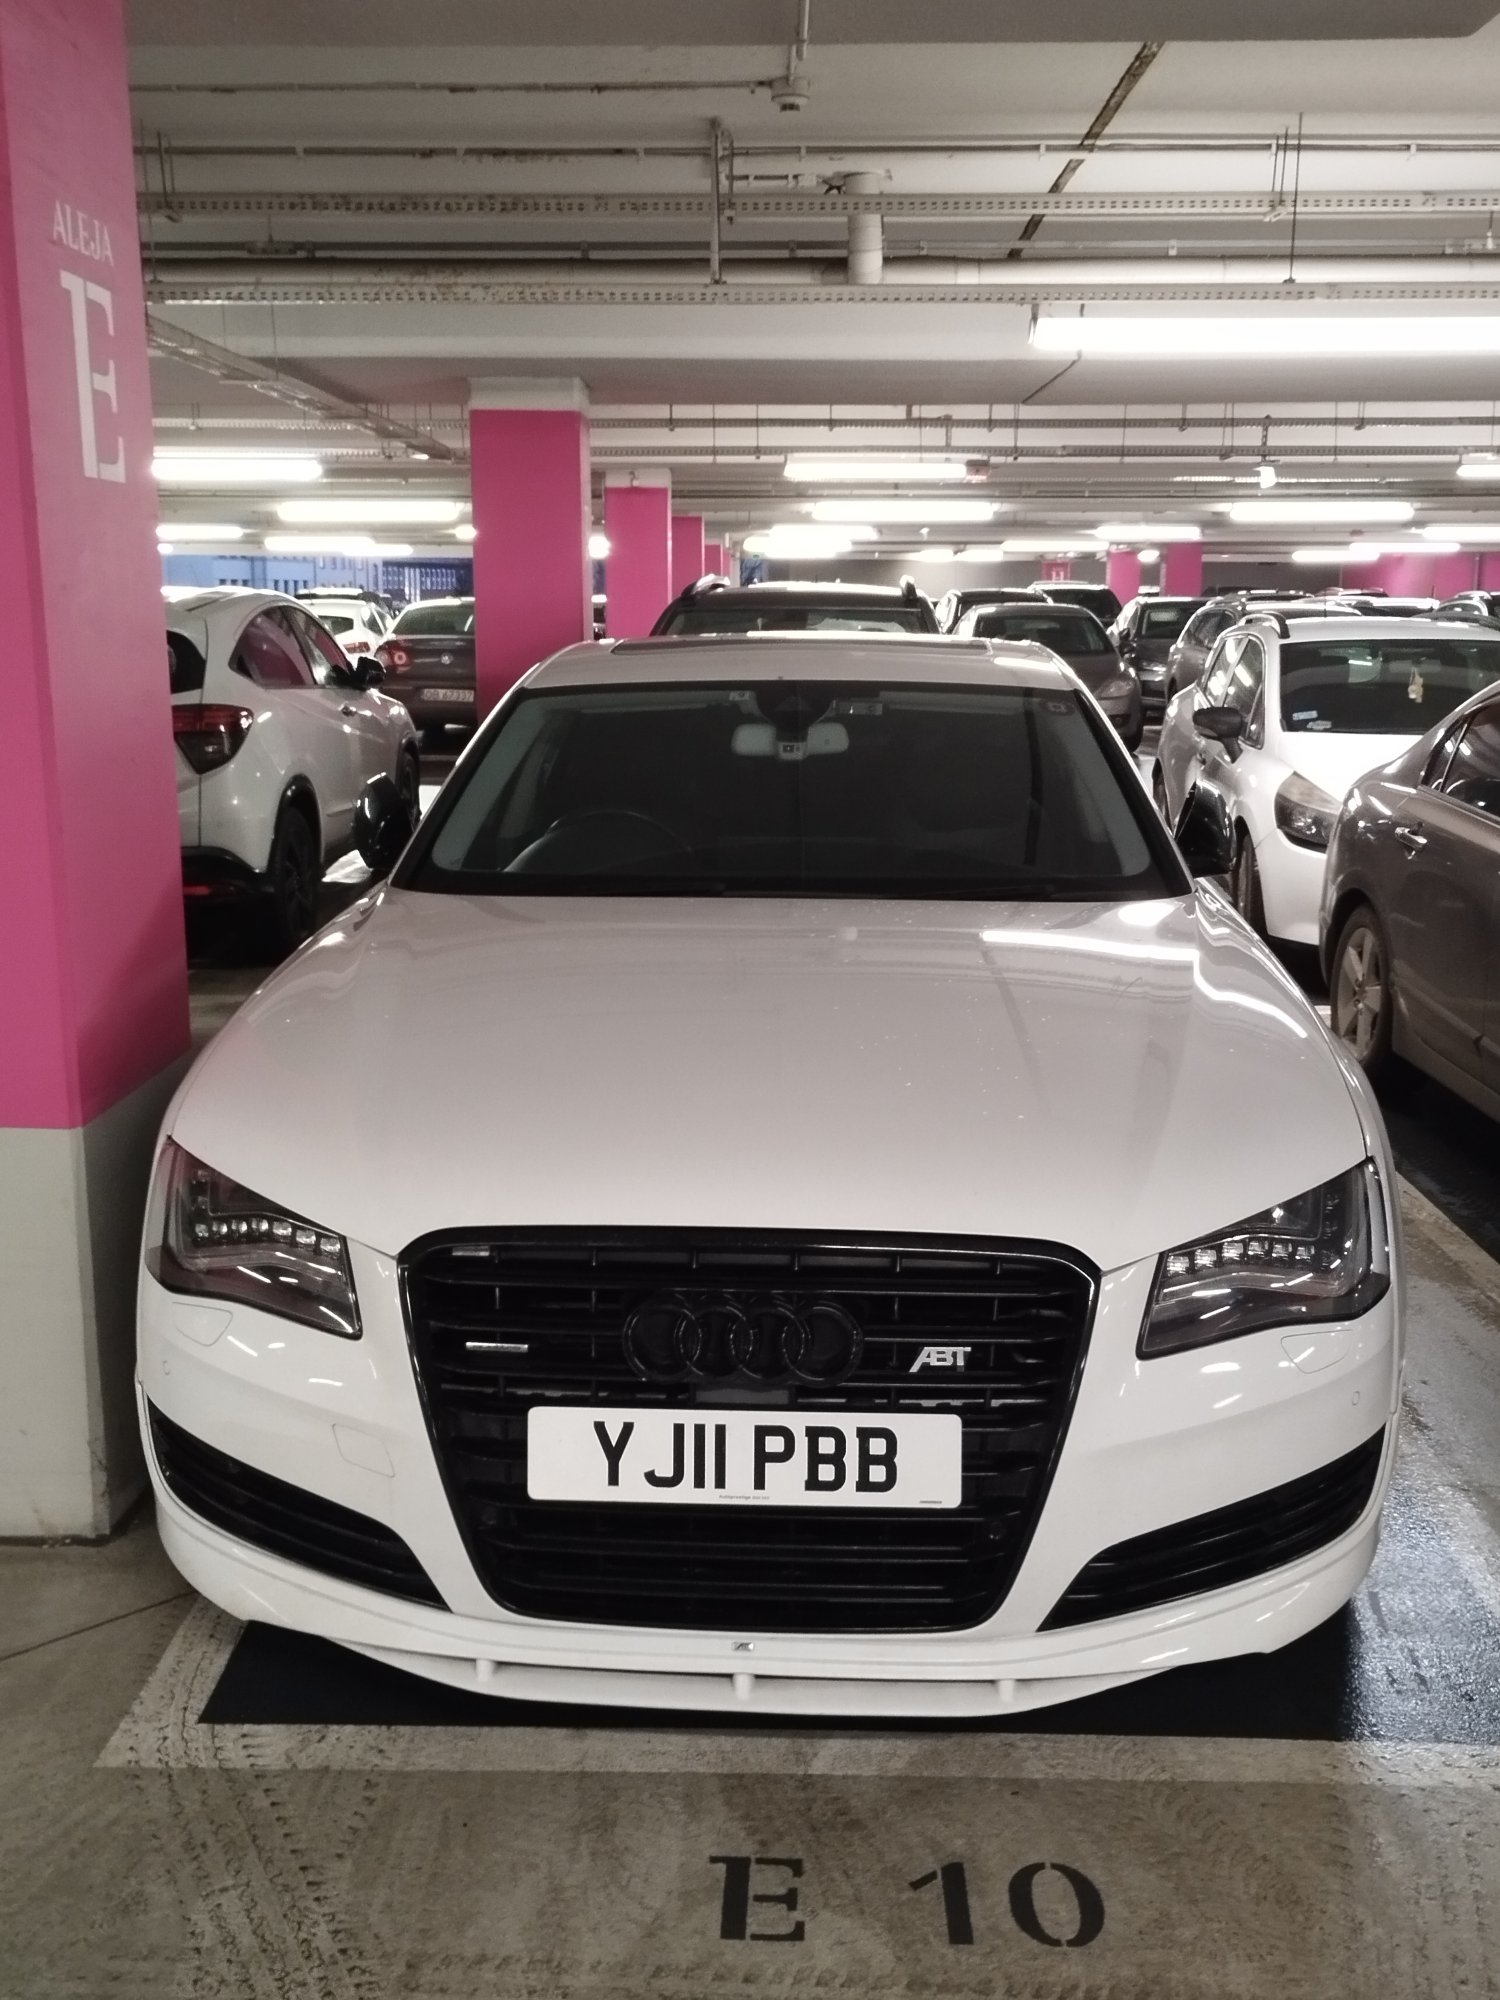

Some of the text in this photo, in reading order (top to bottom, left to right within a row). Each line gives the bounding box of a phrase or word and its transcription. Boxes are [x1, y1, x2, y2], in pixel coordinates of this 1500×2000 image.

[52, 199, 114, 267] ALEJA
[59, 269, 127, 484] E
[908, 1346, 972, 1373] ABT
[593, 1420, 899, 1494] YJ11 PBB
[708, 1855, 1106, 1948] E 10
